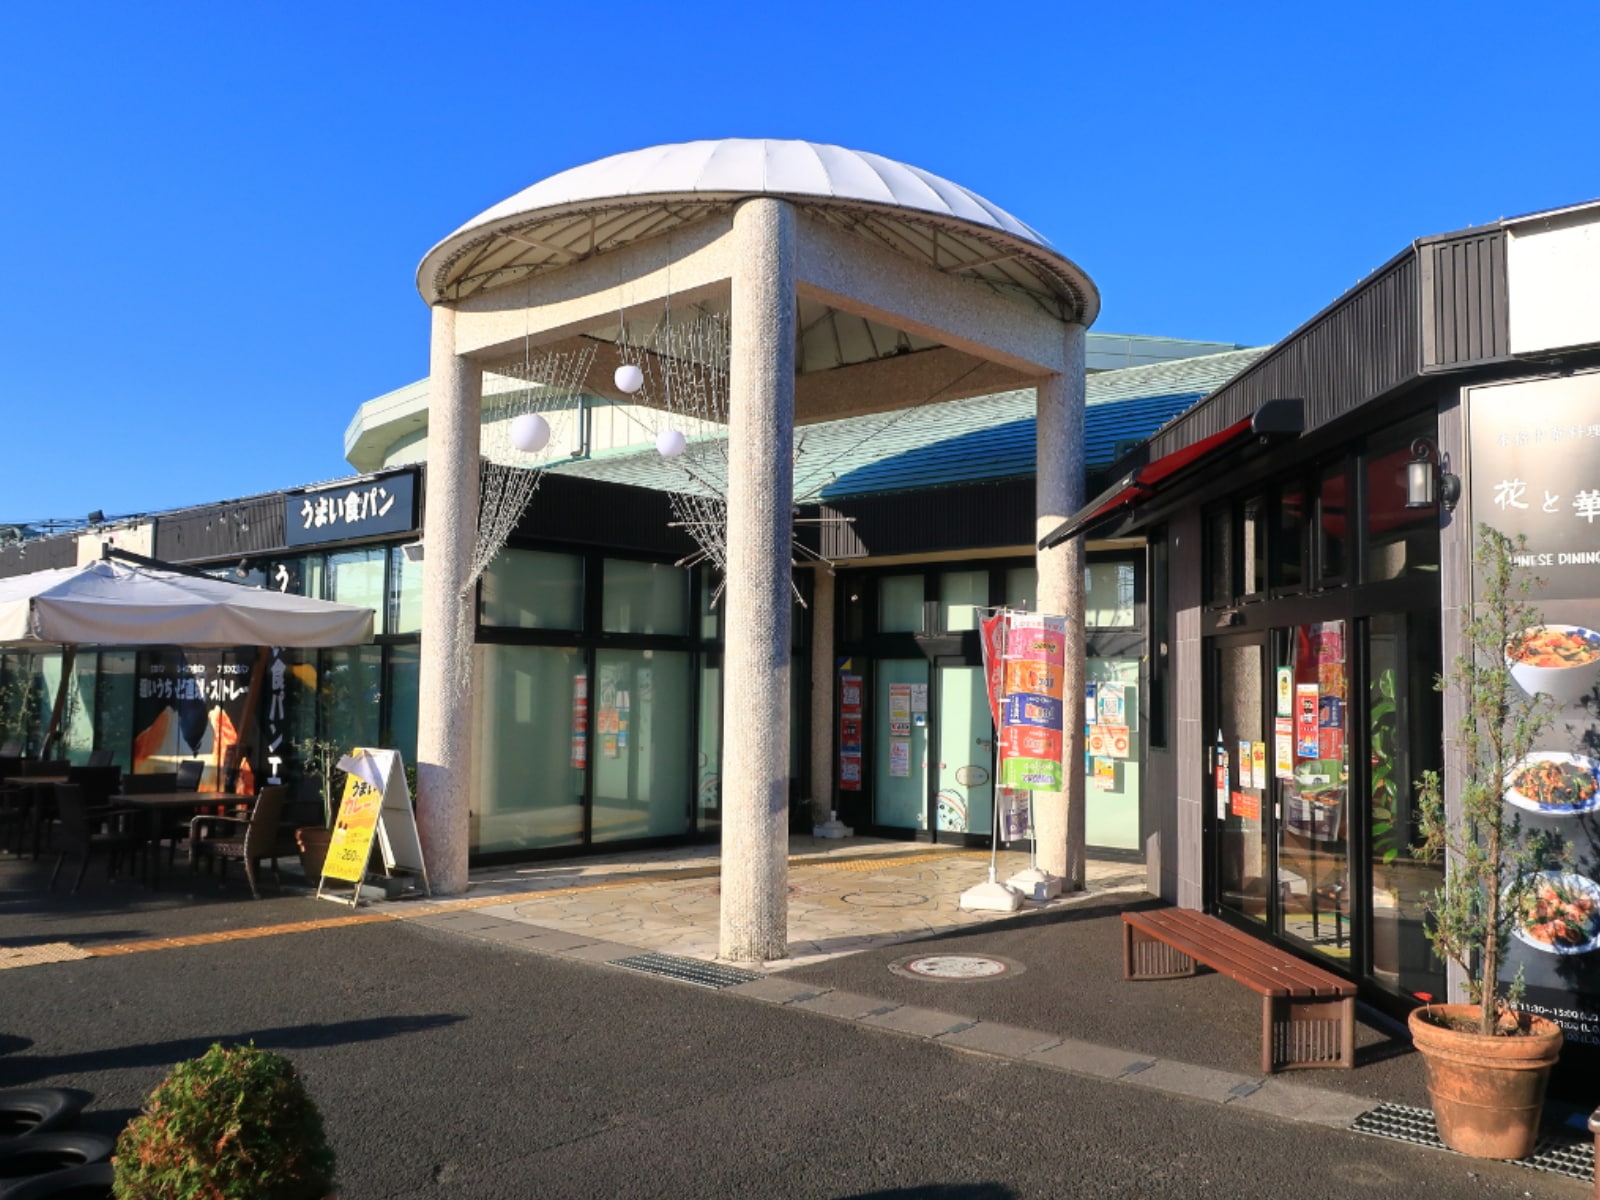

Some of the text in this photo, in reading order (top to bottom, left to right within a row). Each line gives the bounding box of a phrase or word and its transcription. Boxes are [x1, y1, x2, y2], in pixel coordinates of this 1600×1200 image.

[300, 487, 395, 529] うまい食パン
